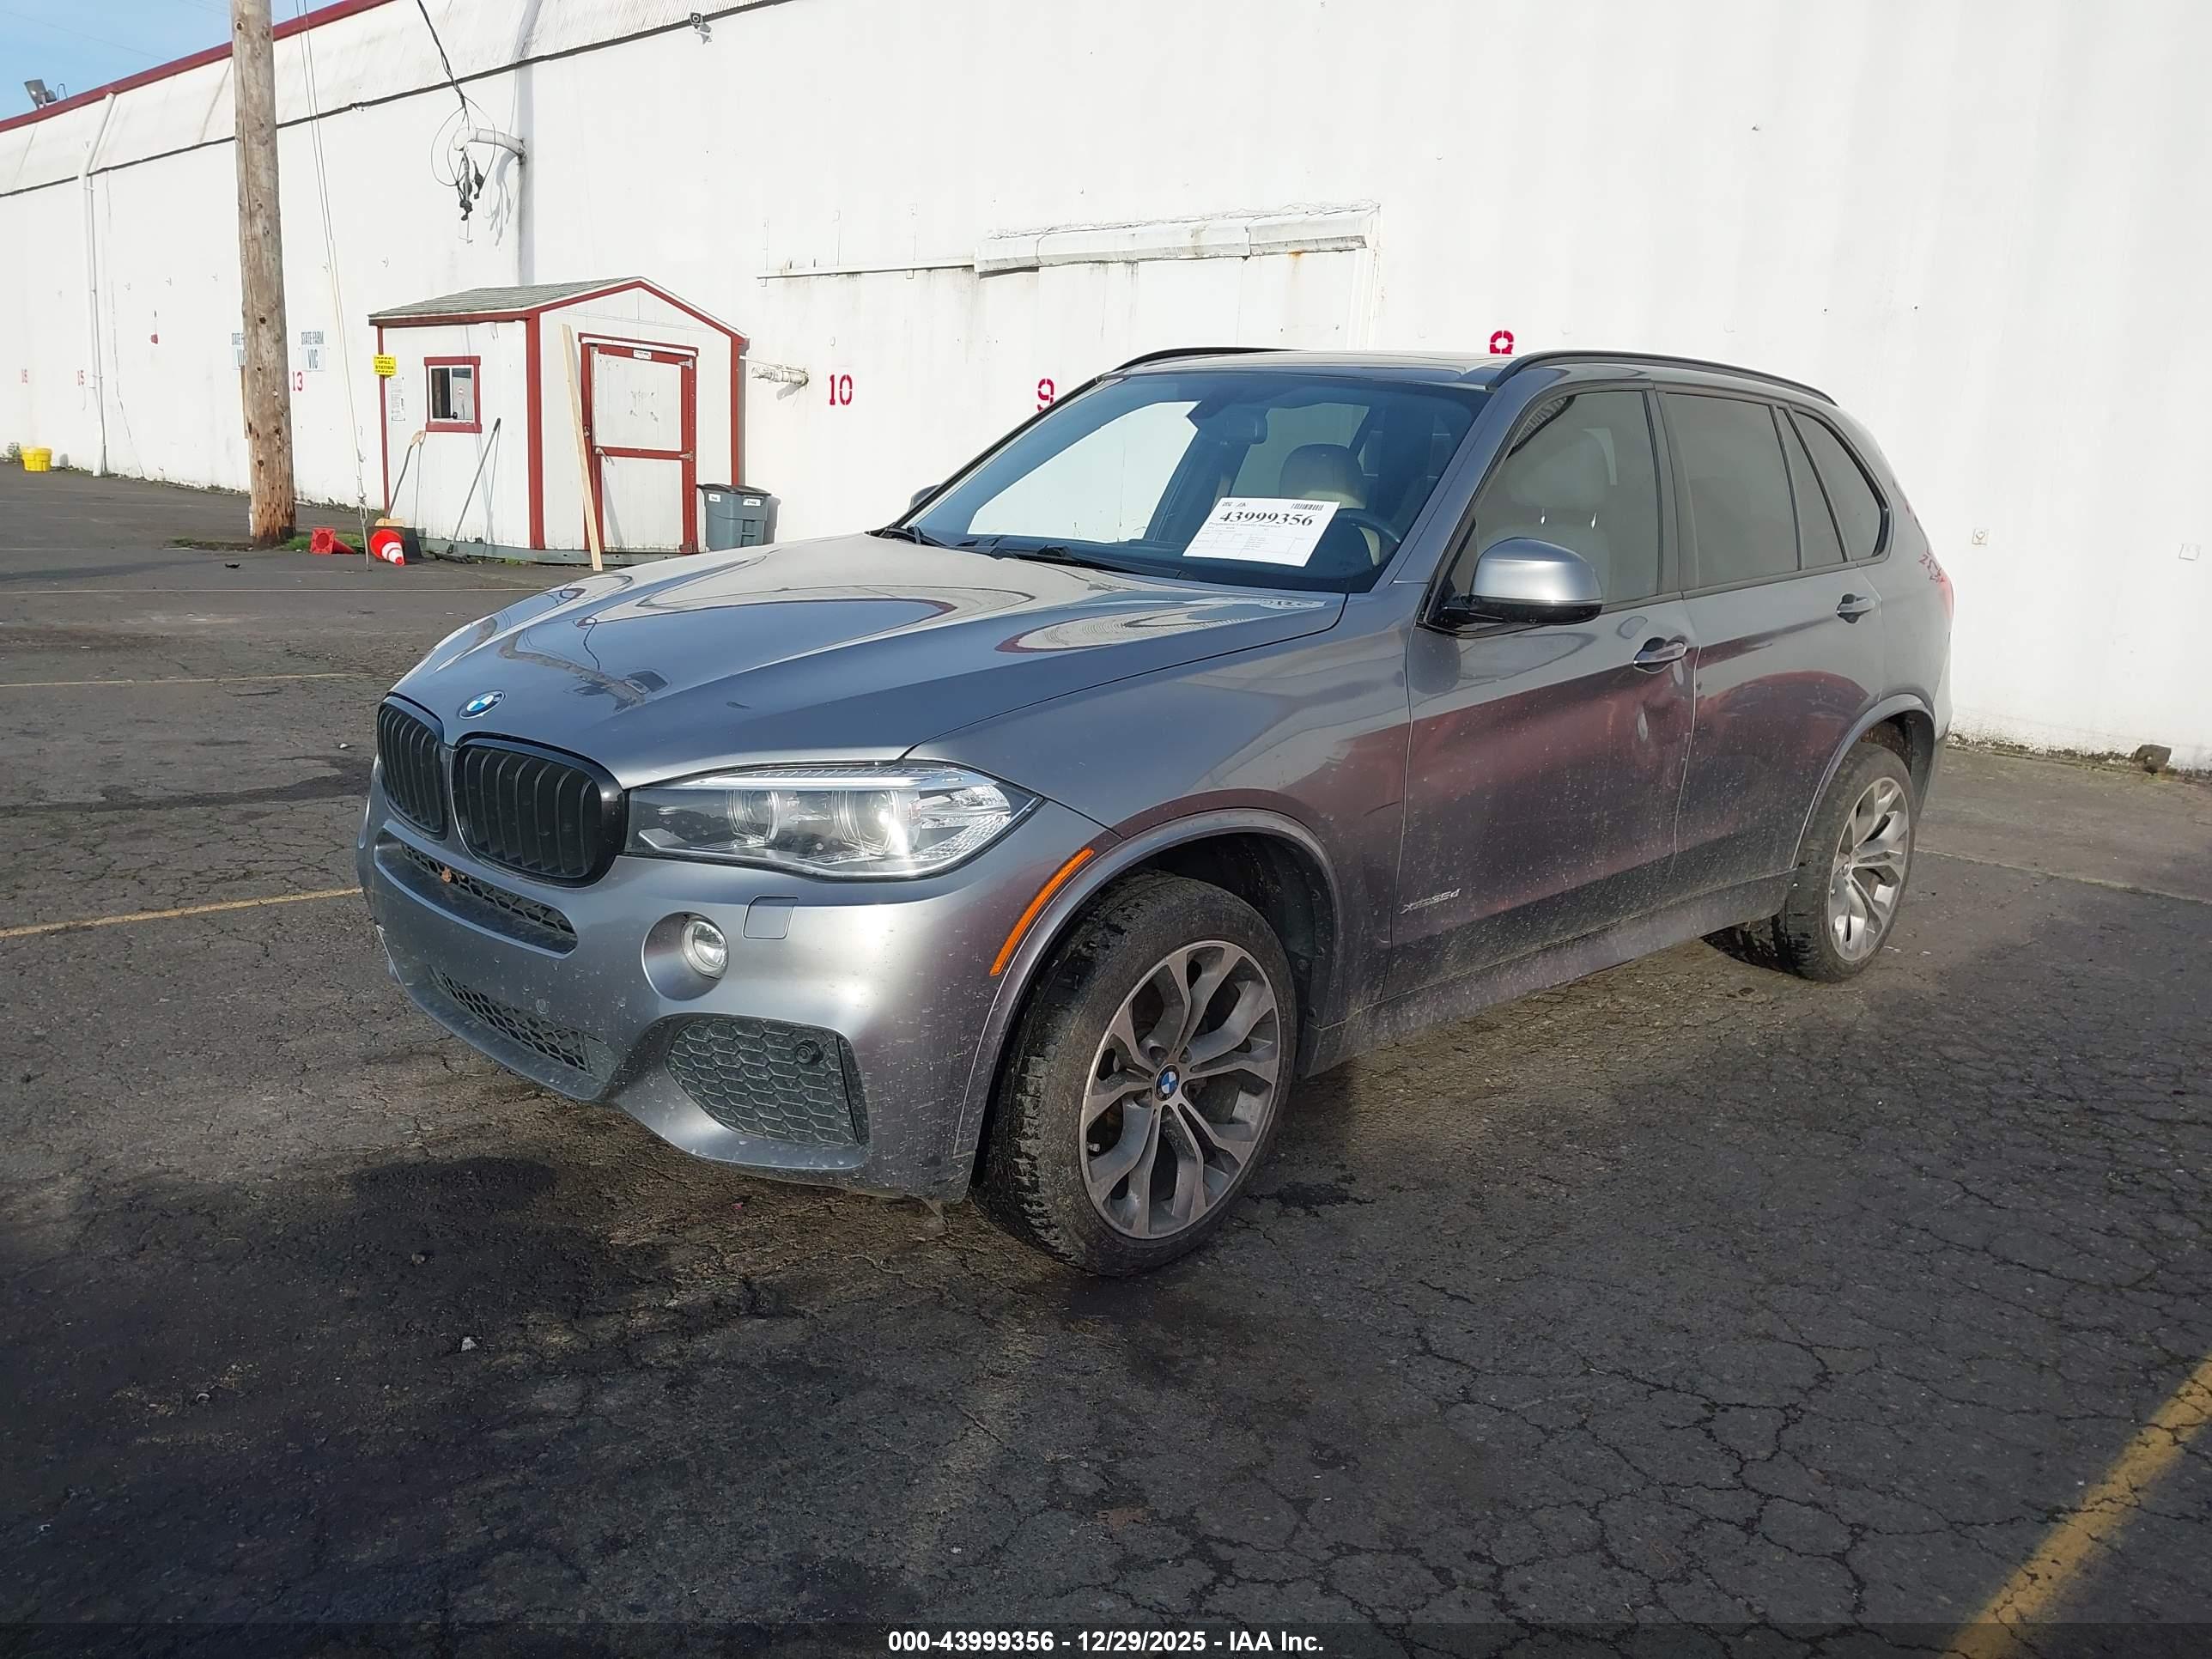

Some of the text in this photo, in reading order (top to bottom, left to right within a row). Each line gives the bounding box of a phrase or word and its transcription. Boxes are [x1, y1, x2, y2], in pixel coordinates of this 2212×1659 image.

[301, 331, 325, 345] STATE FARM
[307, 349, 319, 369] VIC
[77, 369, 85, 386] 15
[292, 371, 303, 392] 13
[829, 374, 853, 405] 10
[1037, 379, 1054, 412] 9
[1219, 511, 1316, 526] 43999356
